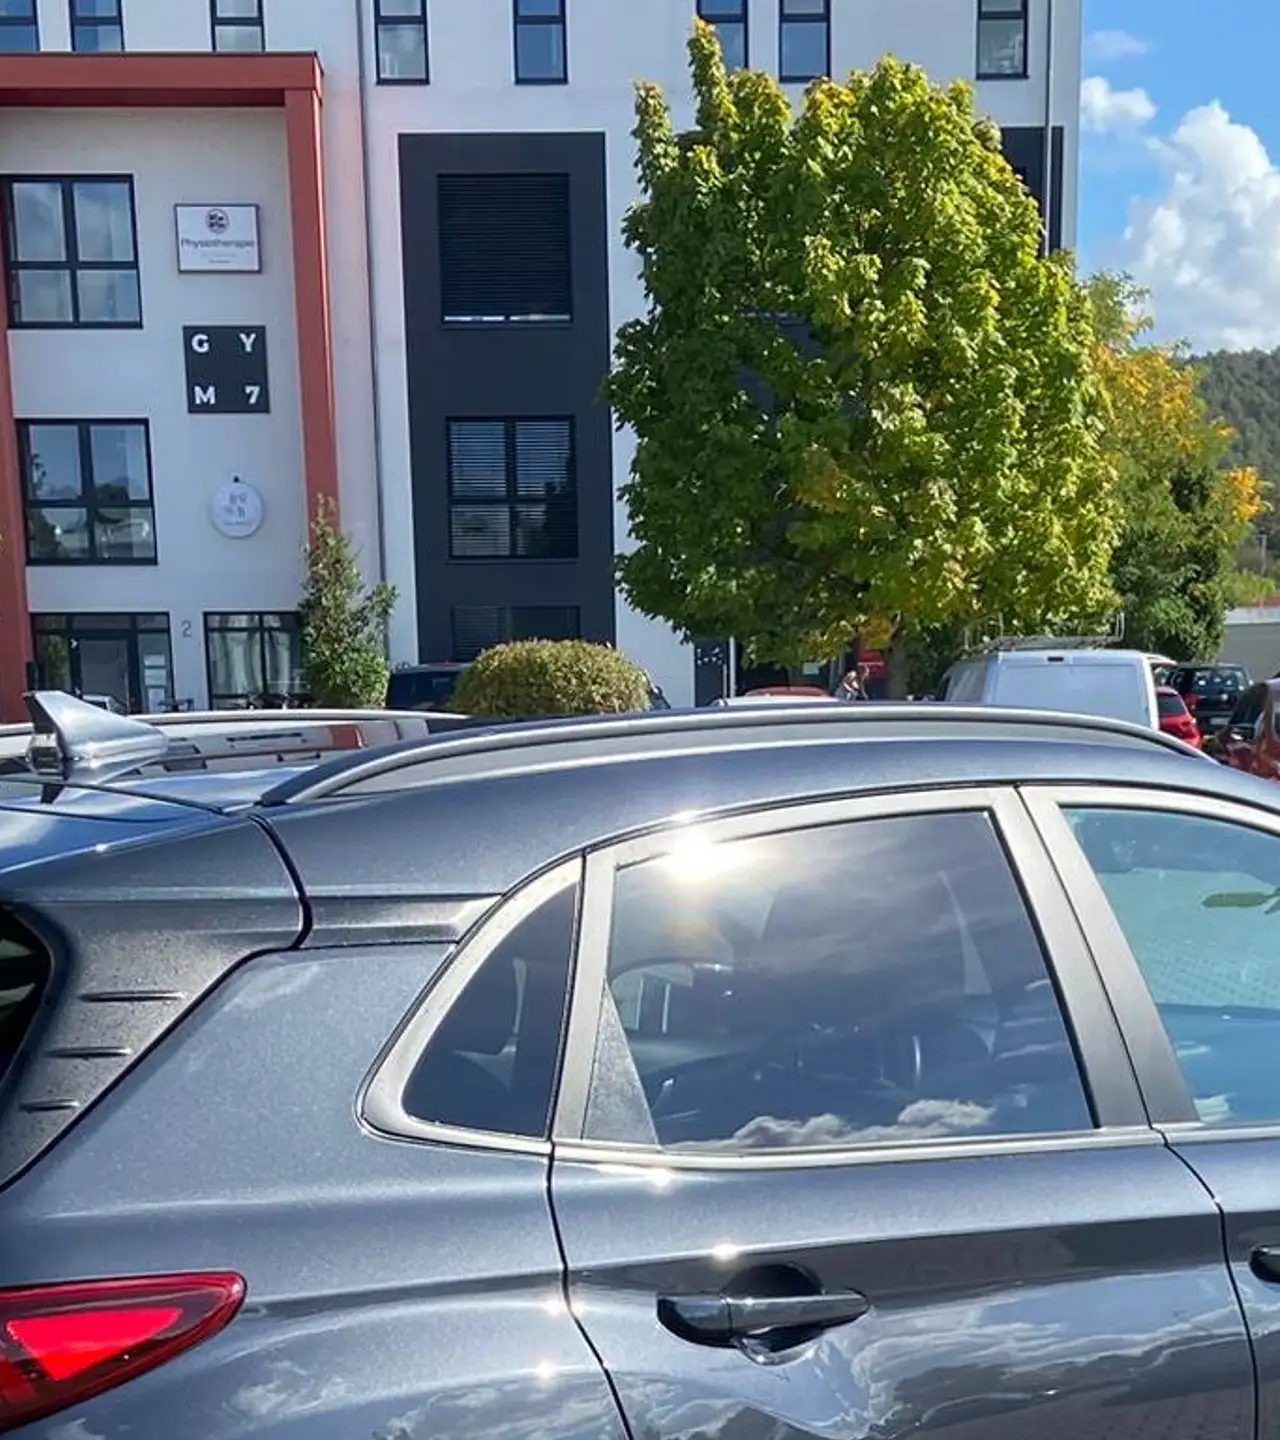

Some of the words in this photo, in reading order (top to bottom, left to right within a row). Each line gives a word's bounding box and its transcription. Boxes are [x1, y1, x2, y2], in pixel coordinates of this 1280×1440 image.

[191, 333, 210, 353] G
[239, 332, 257, 352] Y
[193, 385, 216, 405] M
[244, 385, 261, 404] 7
[180, 620, 193, 638] 2
